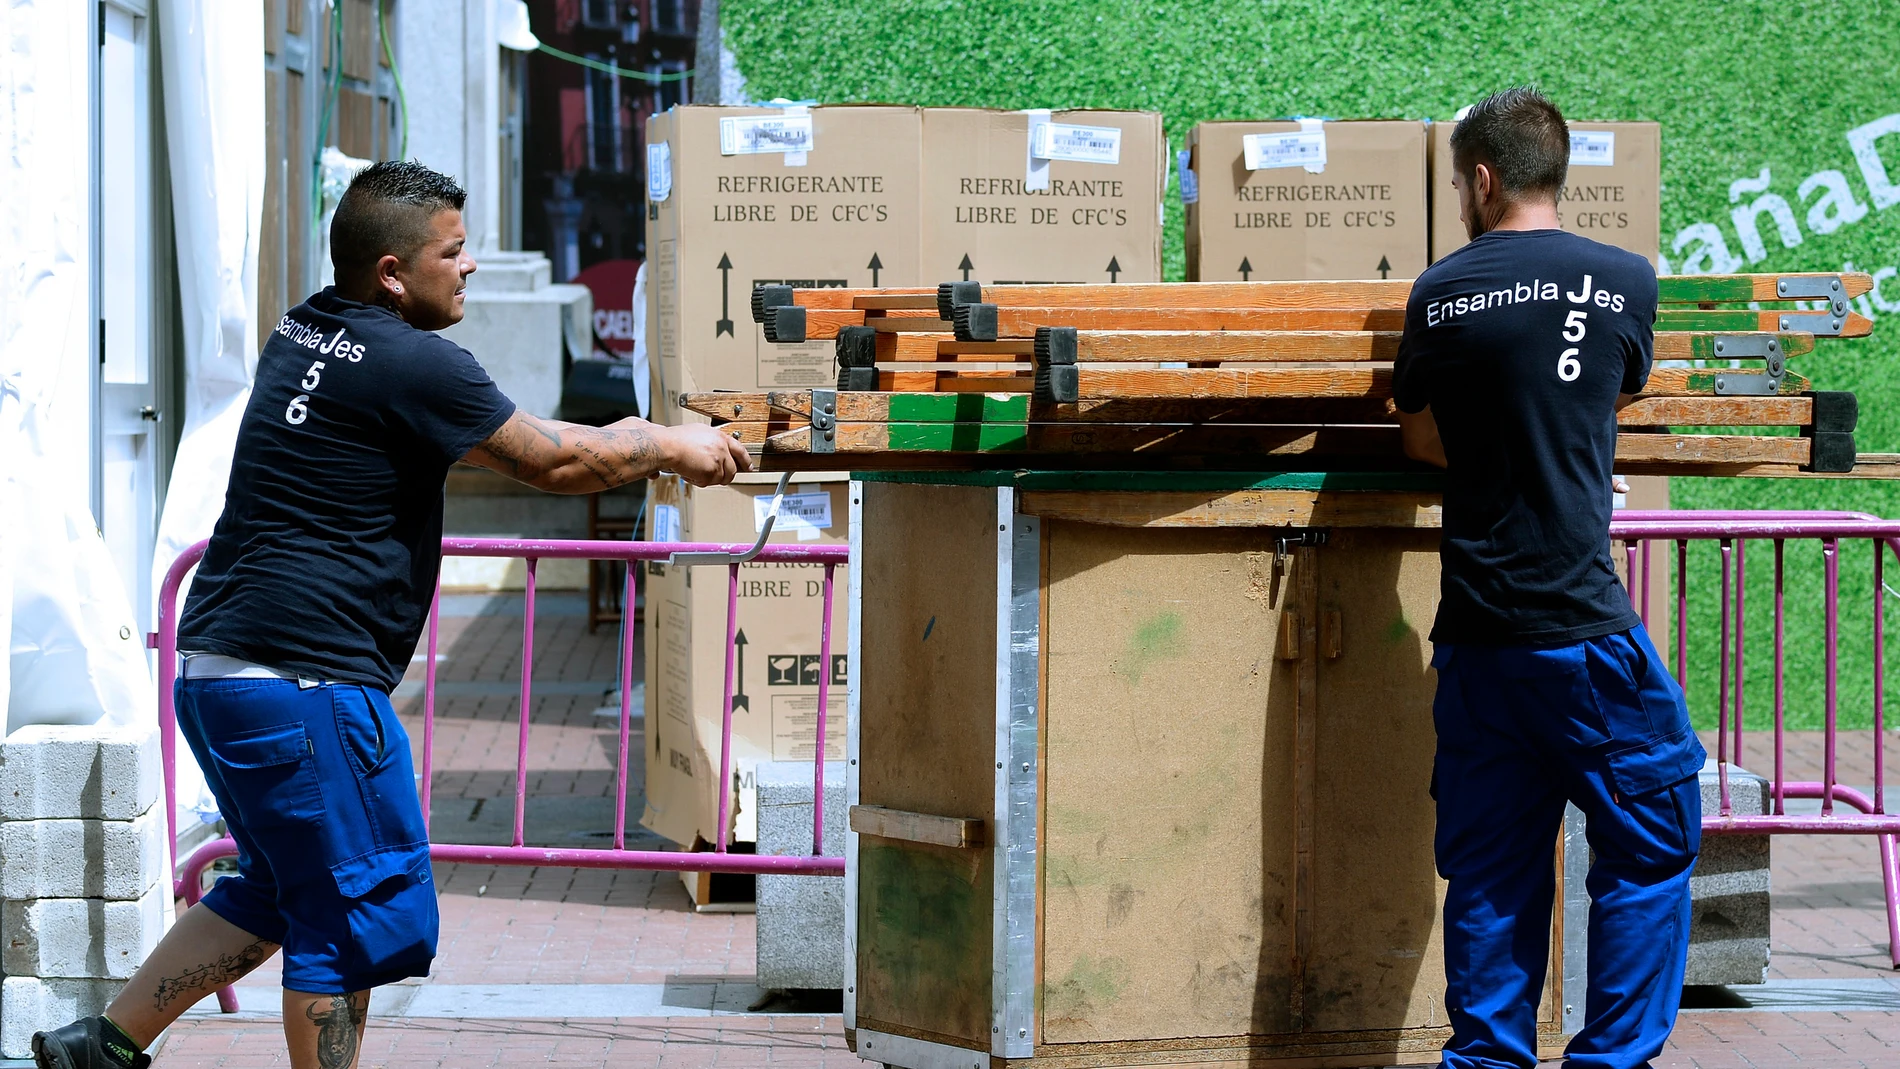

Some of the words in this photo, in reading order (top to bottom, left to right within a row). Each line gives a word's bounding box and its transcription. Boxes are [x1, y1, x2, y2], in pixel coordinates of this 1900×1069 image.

[717, 175, 884, 193] REFRIGERANTE
[960, 177, 1123, 197] REFRIRANTE
[1238, 184, 1391, 202] REFRIGERANTE
[1659, 113, 1900, 276] añaD
[713, 204, 776, 222] LIBRE
[790, 205, 818, 222] DE
[832, 203, 888, 222] CFC'S
[955, 206, 1016, 224] LIBRE
[1031, 207, 1058, 225] DE
[1072, 208, 1127, 226] CFC'S
[1234, 211, 1292, 228] LIBRE
[1306, 211, 1331, 228] DE
[1344, 211, 1396, 228] CFC'S
[1576, 211, 1629, 229] CFC'S
[1562, 309, 1588, 343] 5
[1556, 347, 1582, 382] 6
[301, 360, 326, 391] 5
[285, 394, 310, 425] 6
